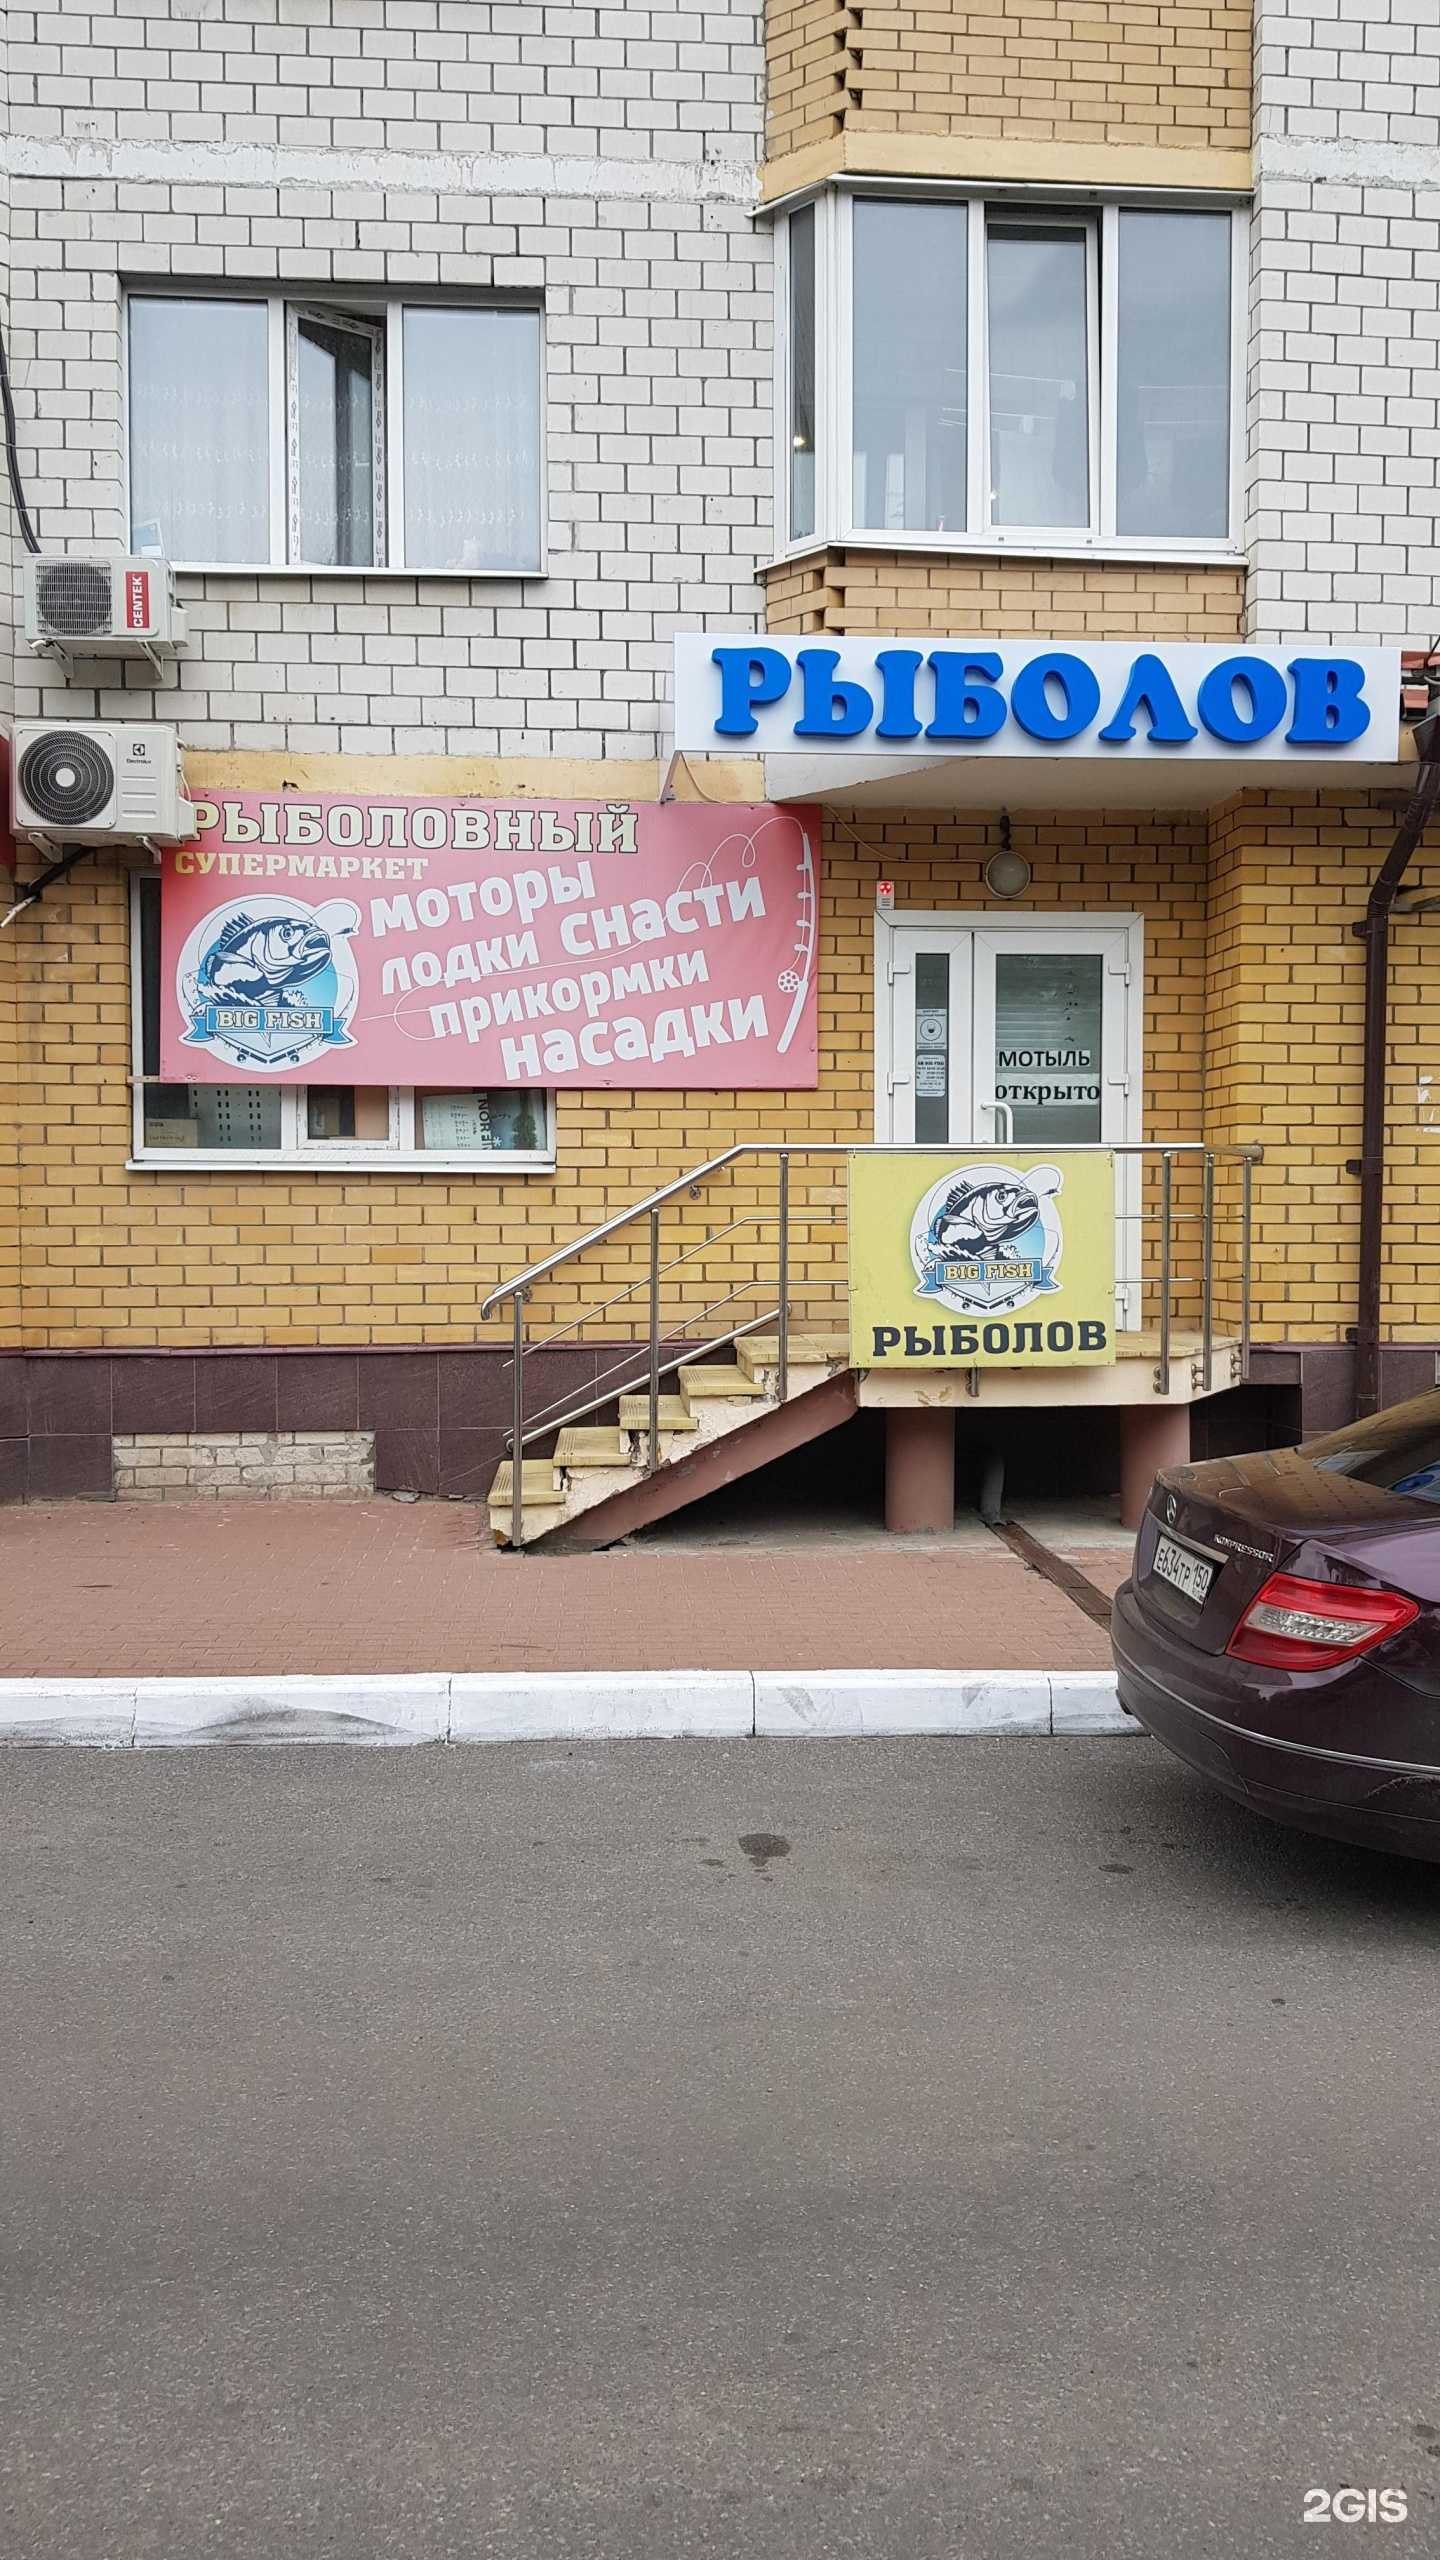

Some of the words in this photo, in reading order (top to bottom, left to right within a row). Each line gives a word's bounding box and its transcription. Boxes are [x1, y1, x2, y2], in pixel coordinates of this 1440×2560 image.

[132, 576, 143, 627] CENTEK
[712, 647, 1371, 745] РЫБОЛОВ
[190, 800, 639, 853] РЫБОЛОВНЫЙ
[175, 852, 428, 880] СУПЕРМАРКЕТ
[218, 1010, 258, 1028] BIG
[266, 1011, 322, 1029] FISH
[999, 1050, 1090, 1067] МОТЫЛЬ
[995, 1084, 1100, 1105] открыто
[943, 1265, 980, 1280] BIG
[985, 1262, 1033, 1279] FISH
[872, 1320, 1108, 1357] РЫБОЛОВ
[1193, 1563, 1209, 1591] 150
